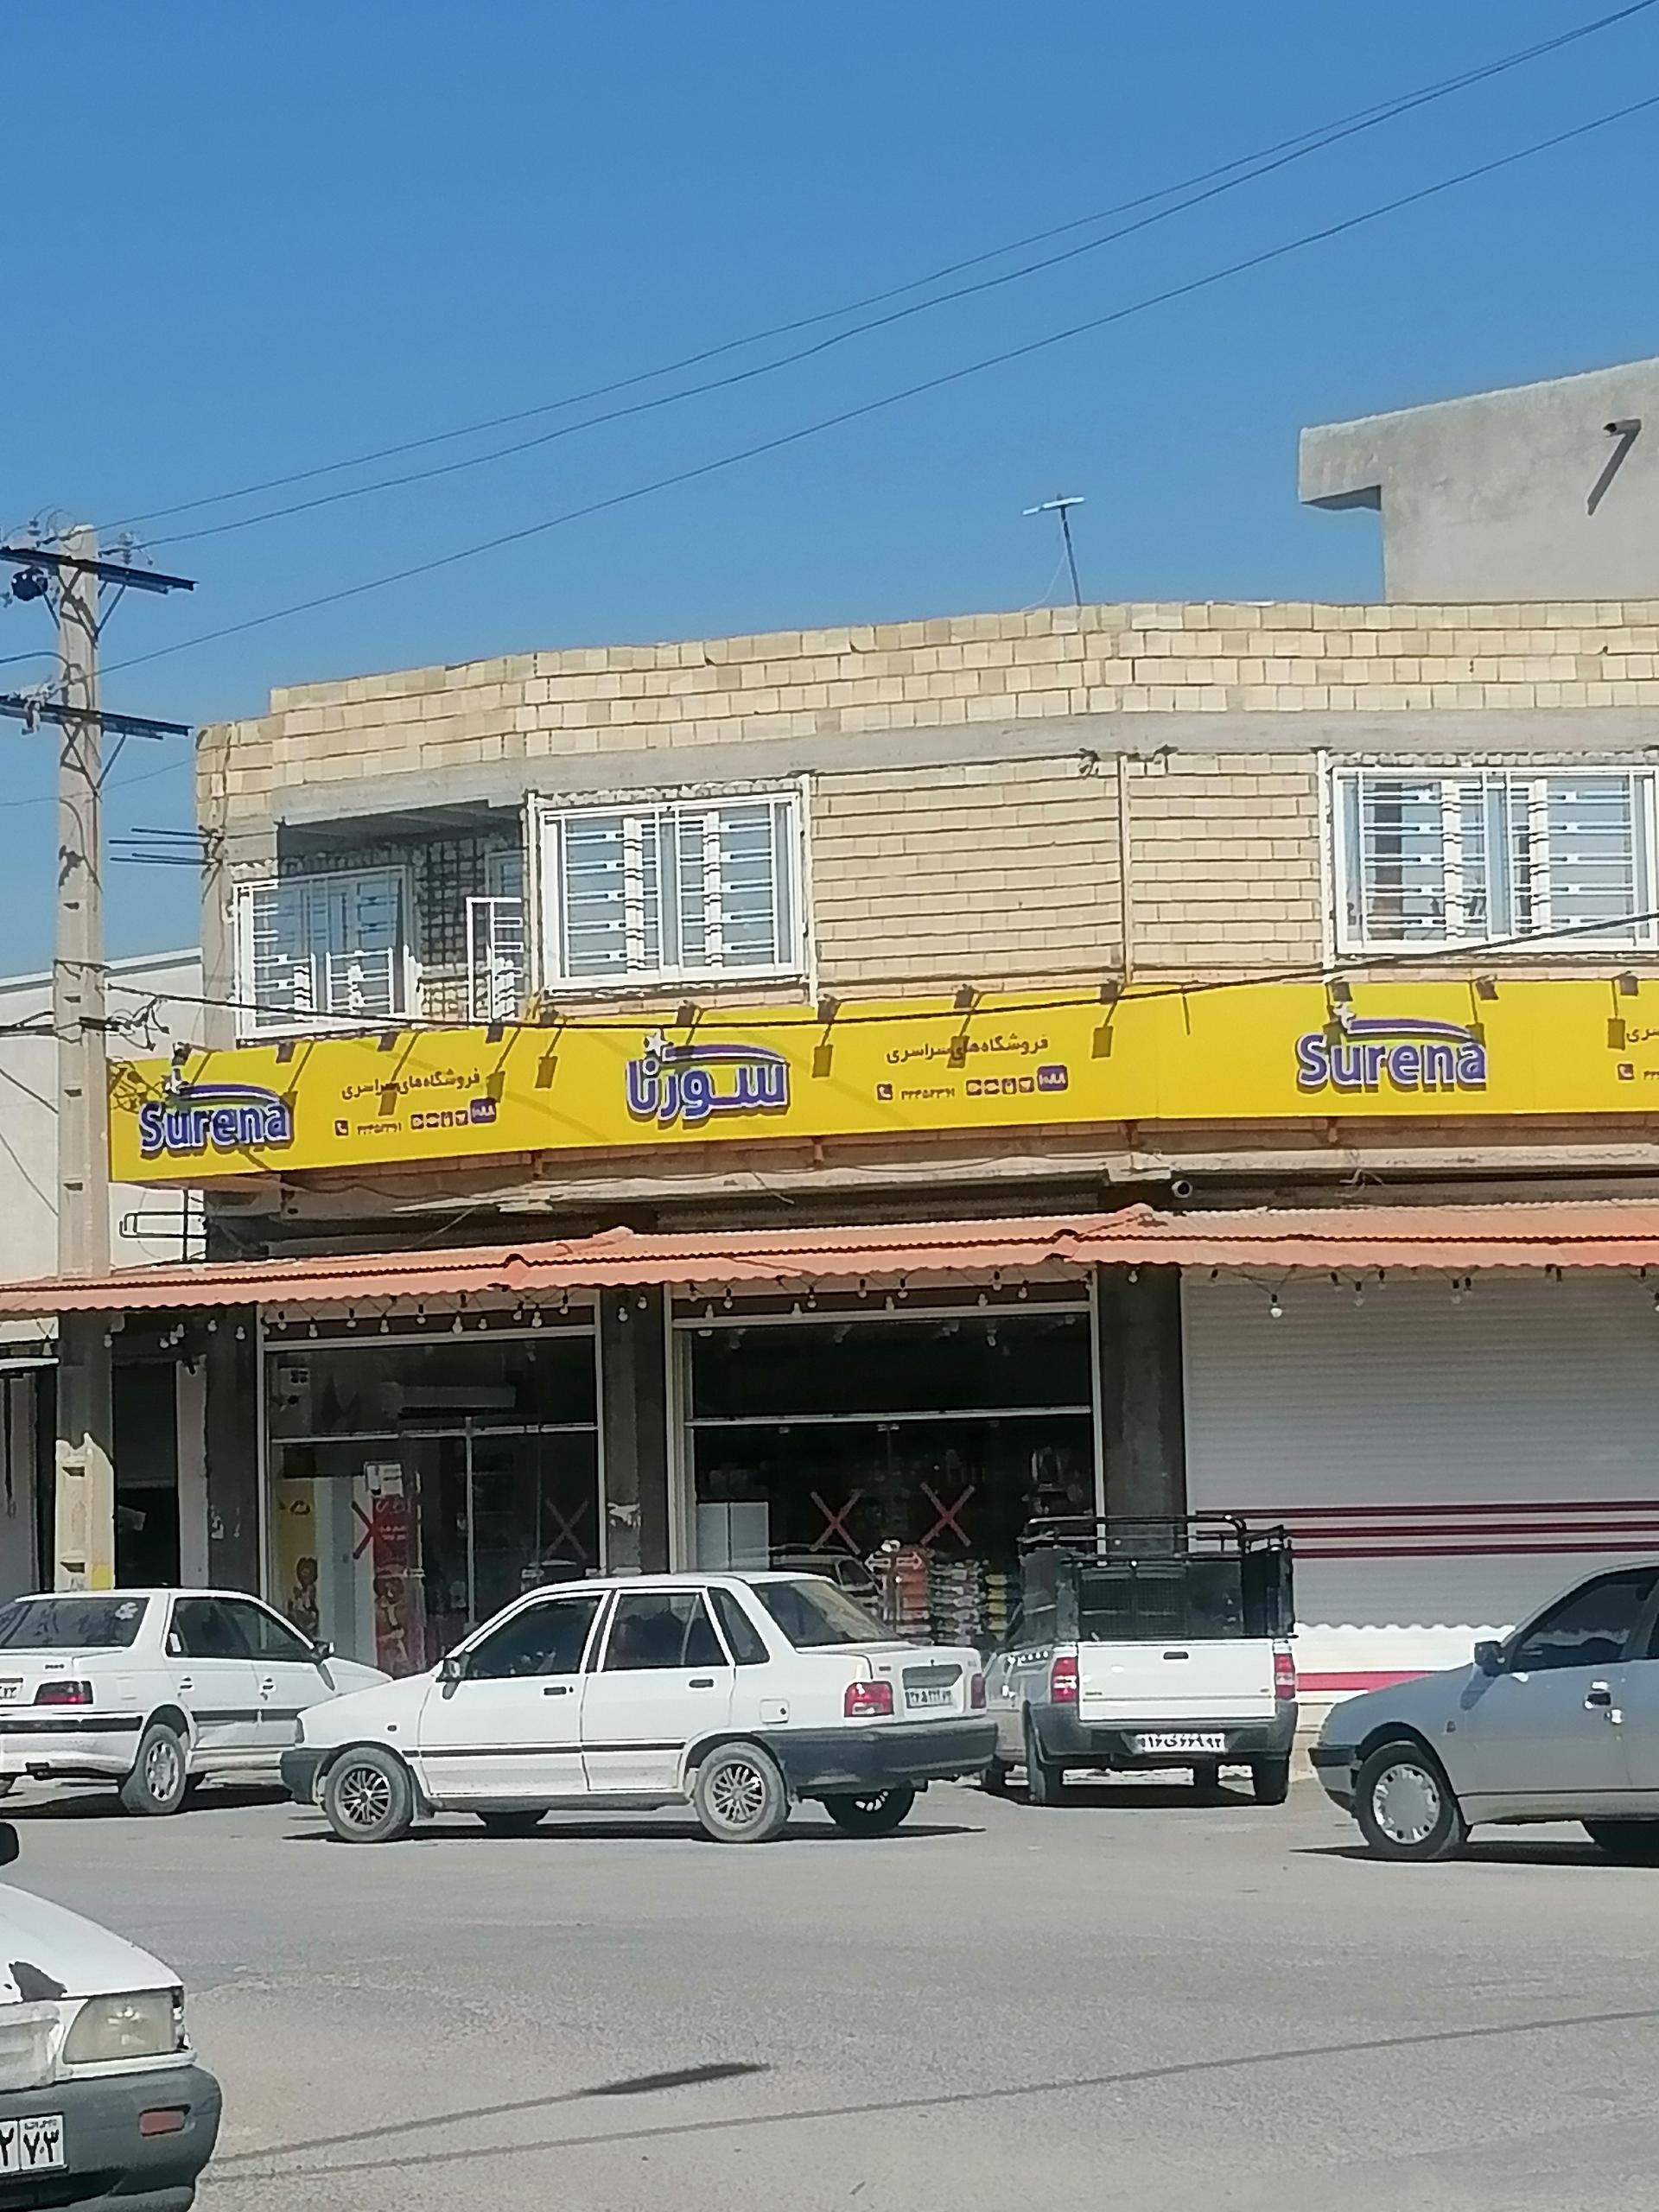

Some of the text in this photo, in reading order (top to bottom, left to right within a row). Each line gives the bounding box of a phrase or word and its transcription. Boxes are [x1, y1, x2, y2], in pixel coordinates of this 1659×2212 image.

[1298, 1033, 1486, 1086] Surena
[626, 1058, 787, 1121] سورنا
[139, 1102, 291, 1151] Surena
[23, 2129, 60, 2165] ۷۳
